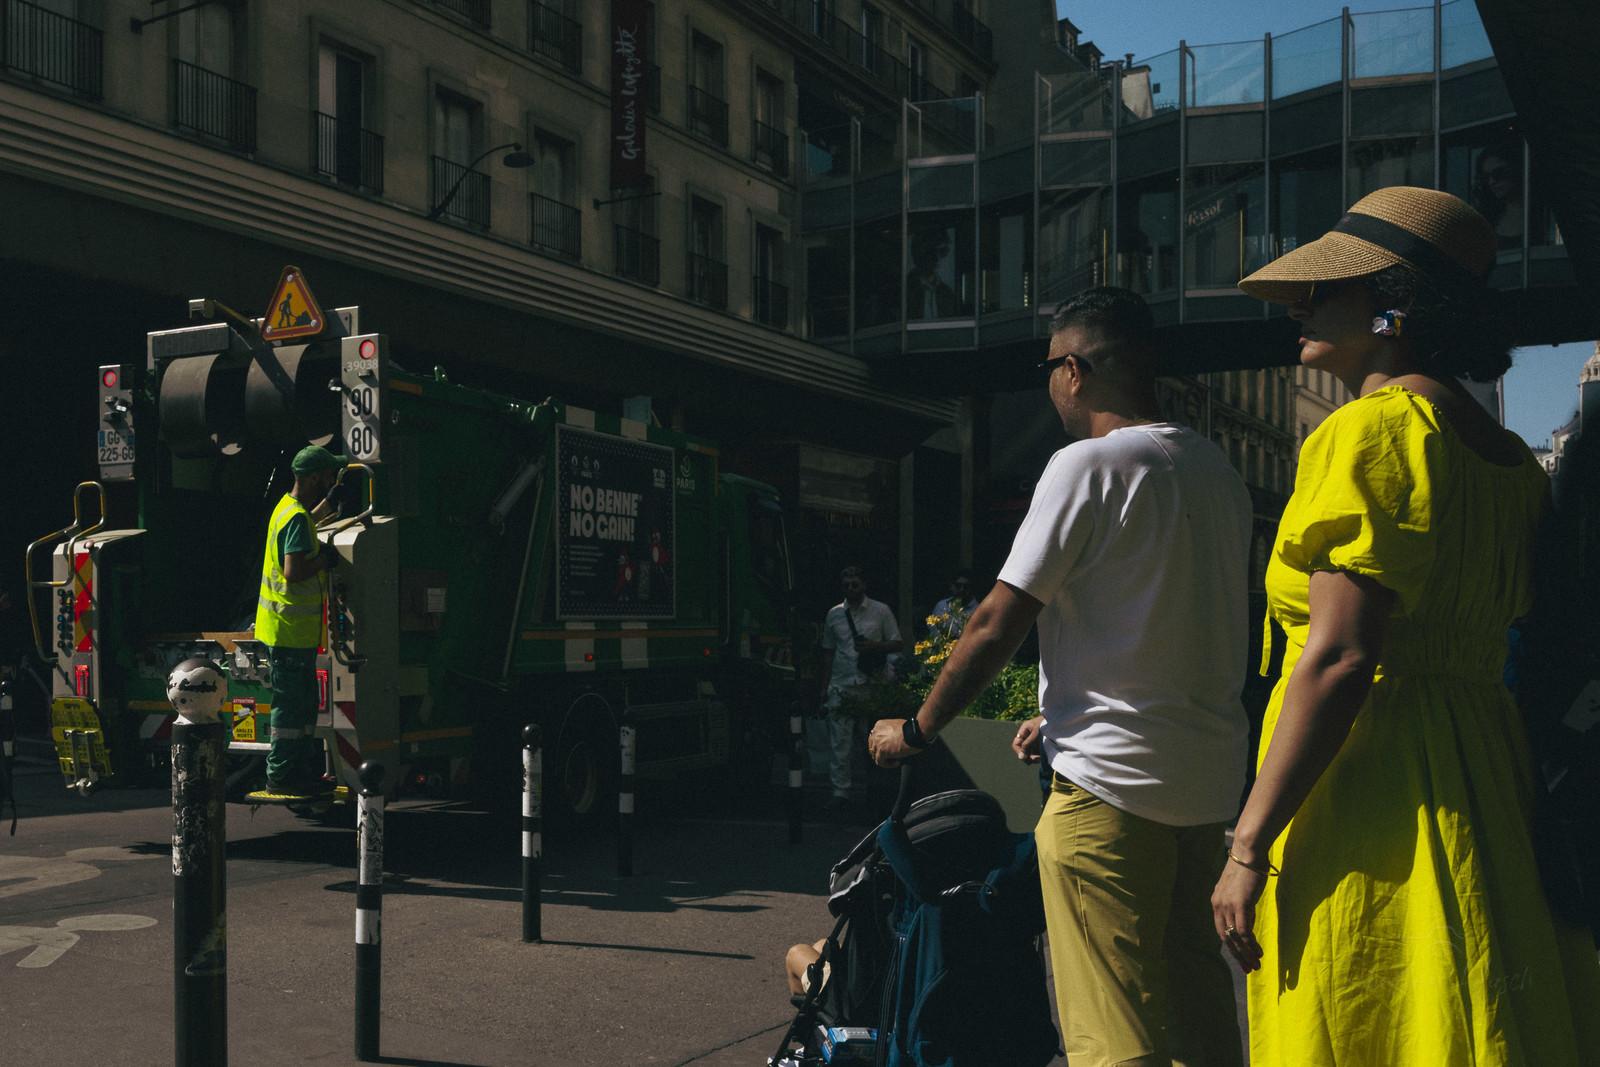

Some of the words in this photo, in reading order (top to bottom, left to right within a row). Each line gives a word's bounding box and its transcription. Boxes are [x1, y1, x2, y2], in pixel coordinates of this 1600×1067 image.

[616, 100, 642, 160] Galeries
[1184, 198, 1224, 226] Persol
[346, 359, 379, 372] 39038
[351, 387, 373, 417] 90
[100, 447, 134, 462] 225-GG
[351, 425, 373, 456] 80
[570, 483, 595, 511] NO
[676, 476, 696, 491] PARIS
[570, 511, 595, 538] NO
[596, 514, 635, 542] GAIN!
